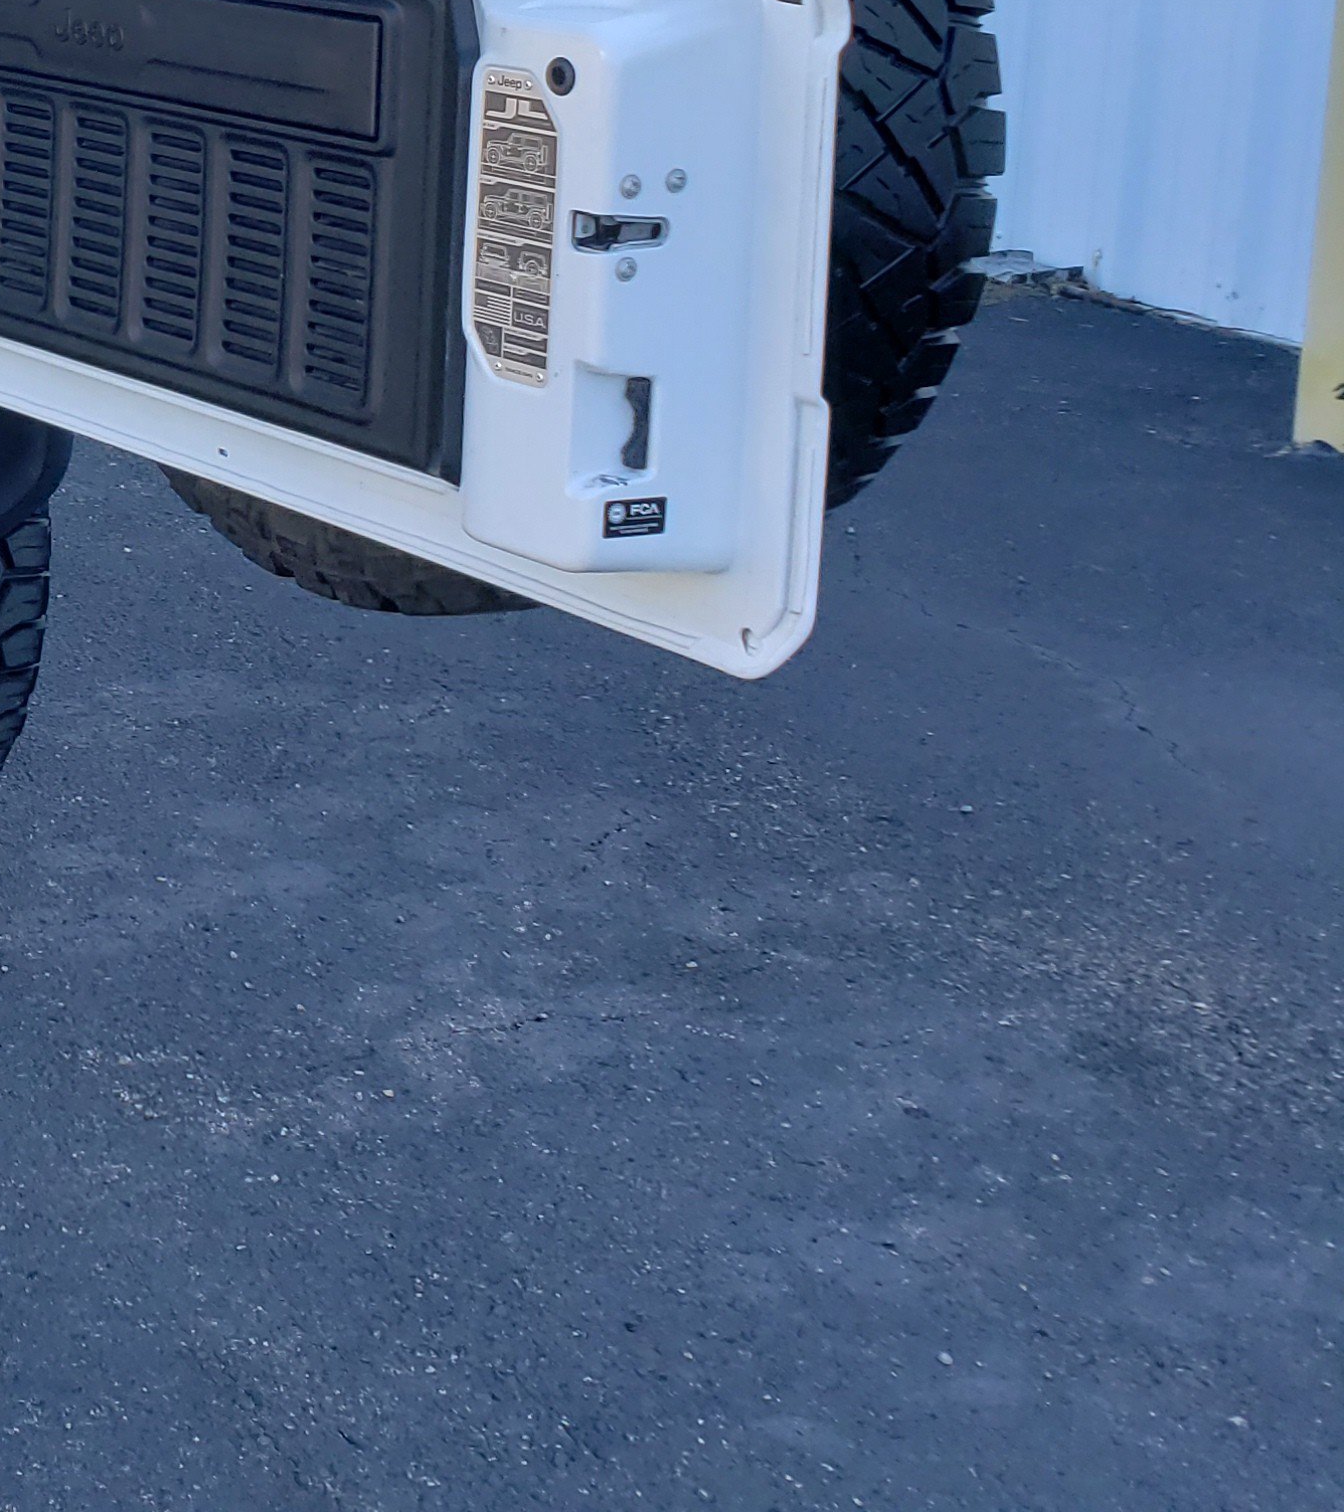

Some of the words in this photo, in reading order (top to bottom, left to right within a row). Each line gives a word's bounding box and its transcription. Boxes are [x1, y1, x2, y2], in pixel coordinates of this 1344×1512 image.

[497, 75, 522, 90] Jeep
[485, 97, 549, 120] JL
[513, 311, 546, 329] USA
[629, 503, 660, 515] FCA
